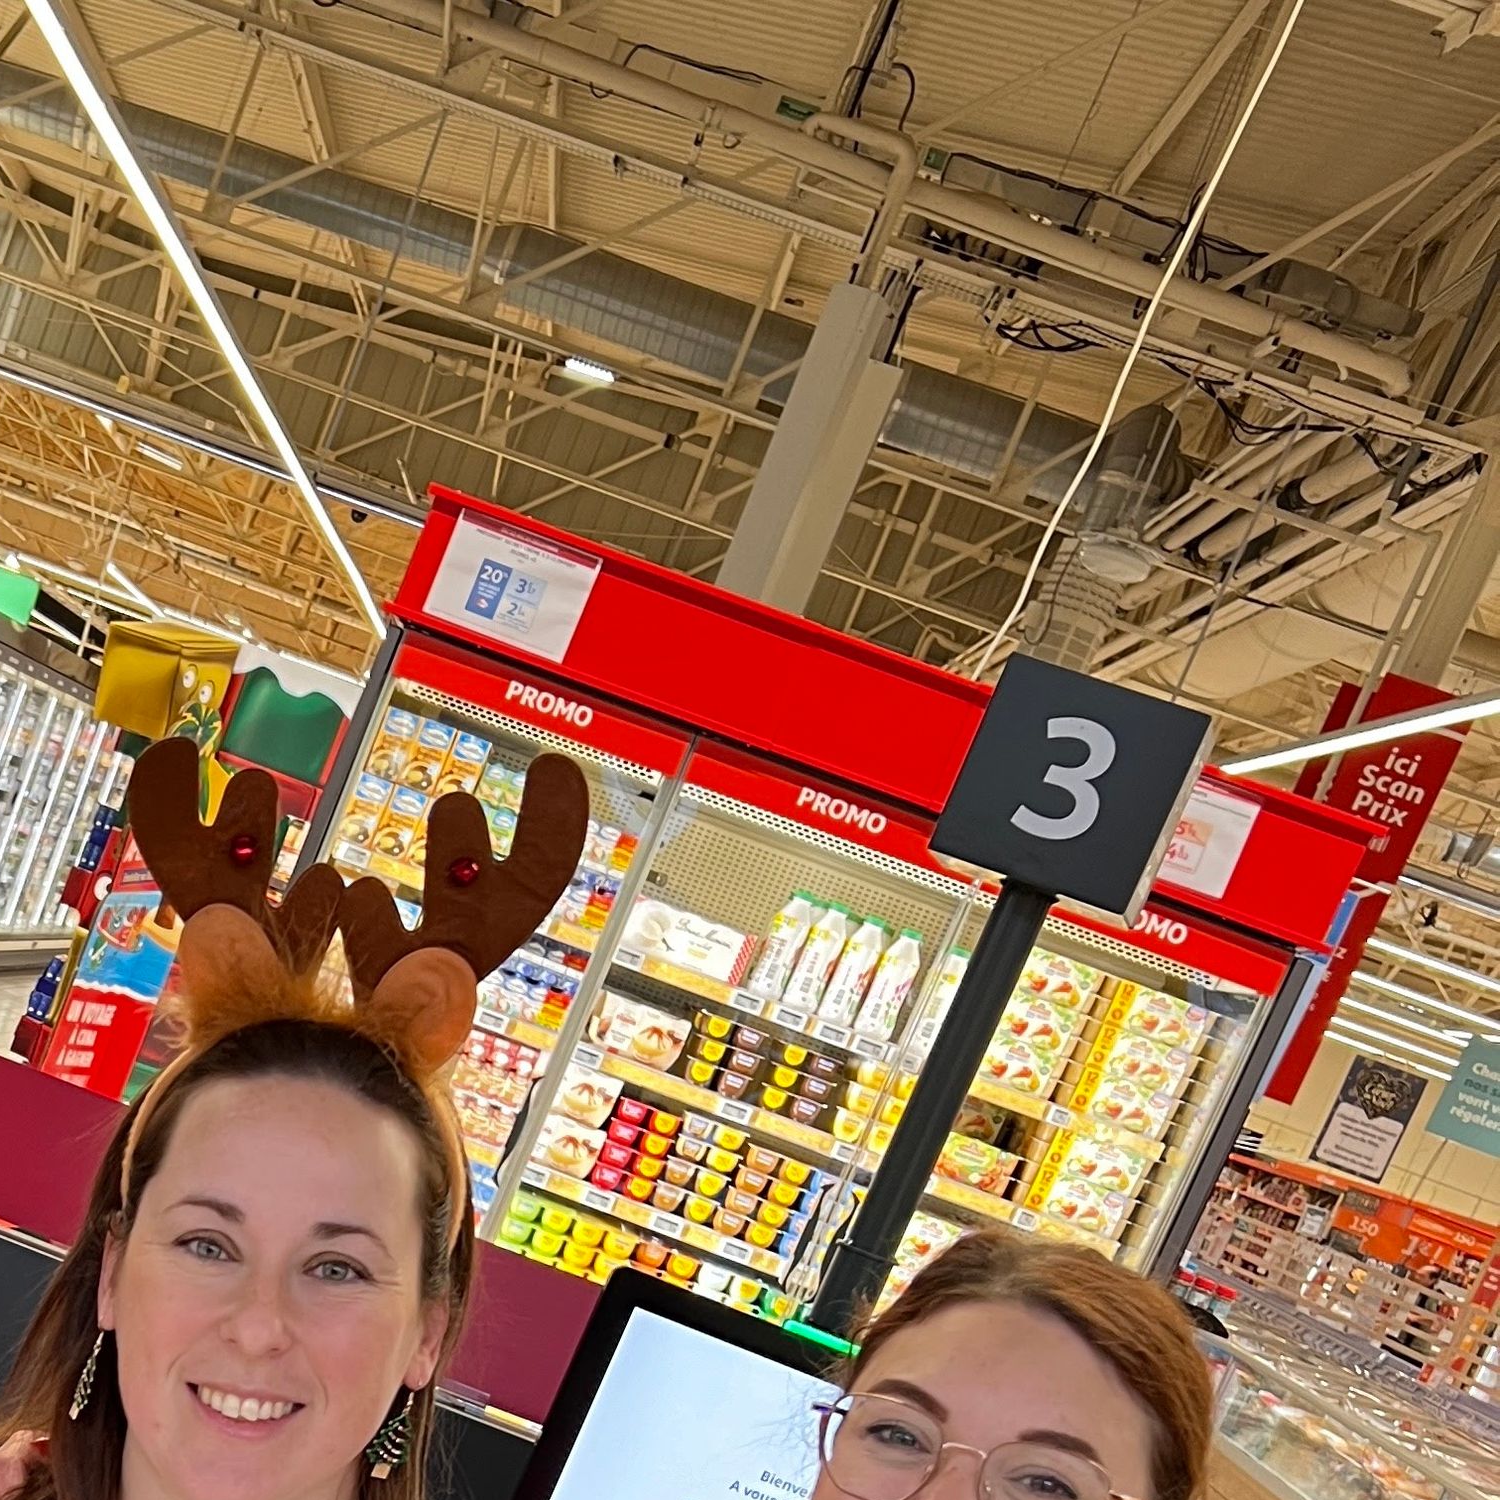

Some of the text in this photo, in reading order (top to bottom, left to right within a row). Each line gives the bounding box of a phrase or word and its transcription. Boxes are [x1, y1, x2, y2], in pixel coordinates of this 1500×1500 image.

[505, 680, 593, 727] PROMO
[1010, 717, 1117, 840] 3
[1384, 747, 1422, 777] ici
[1358, 764, 1425, 805] Scan
[796, 786, 888, 834] PROMO
[1351, 790, 1409, 827] Prix
[1133, 909, 1188, 945] OMO
[1349, 1216, 1379, 1237] 150
[729, 1480, 740, 1493] A
[760, 1470, 809, 1499] Bienve
